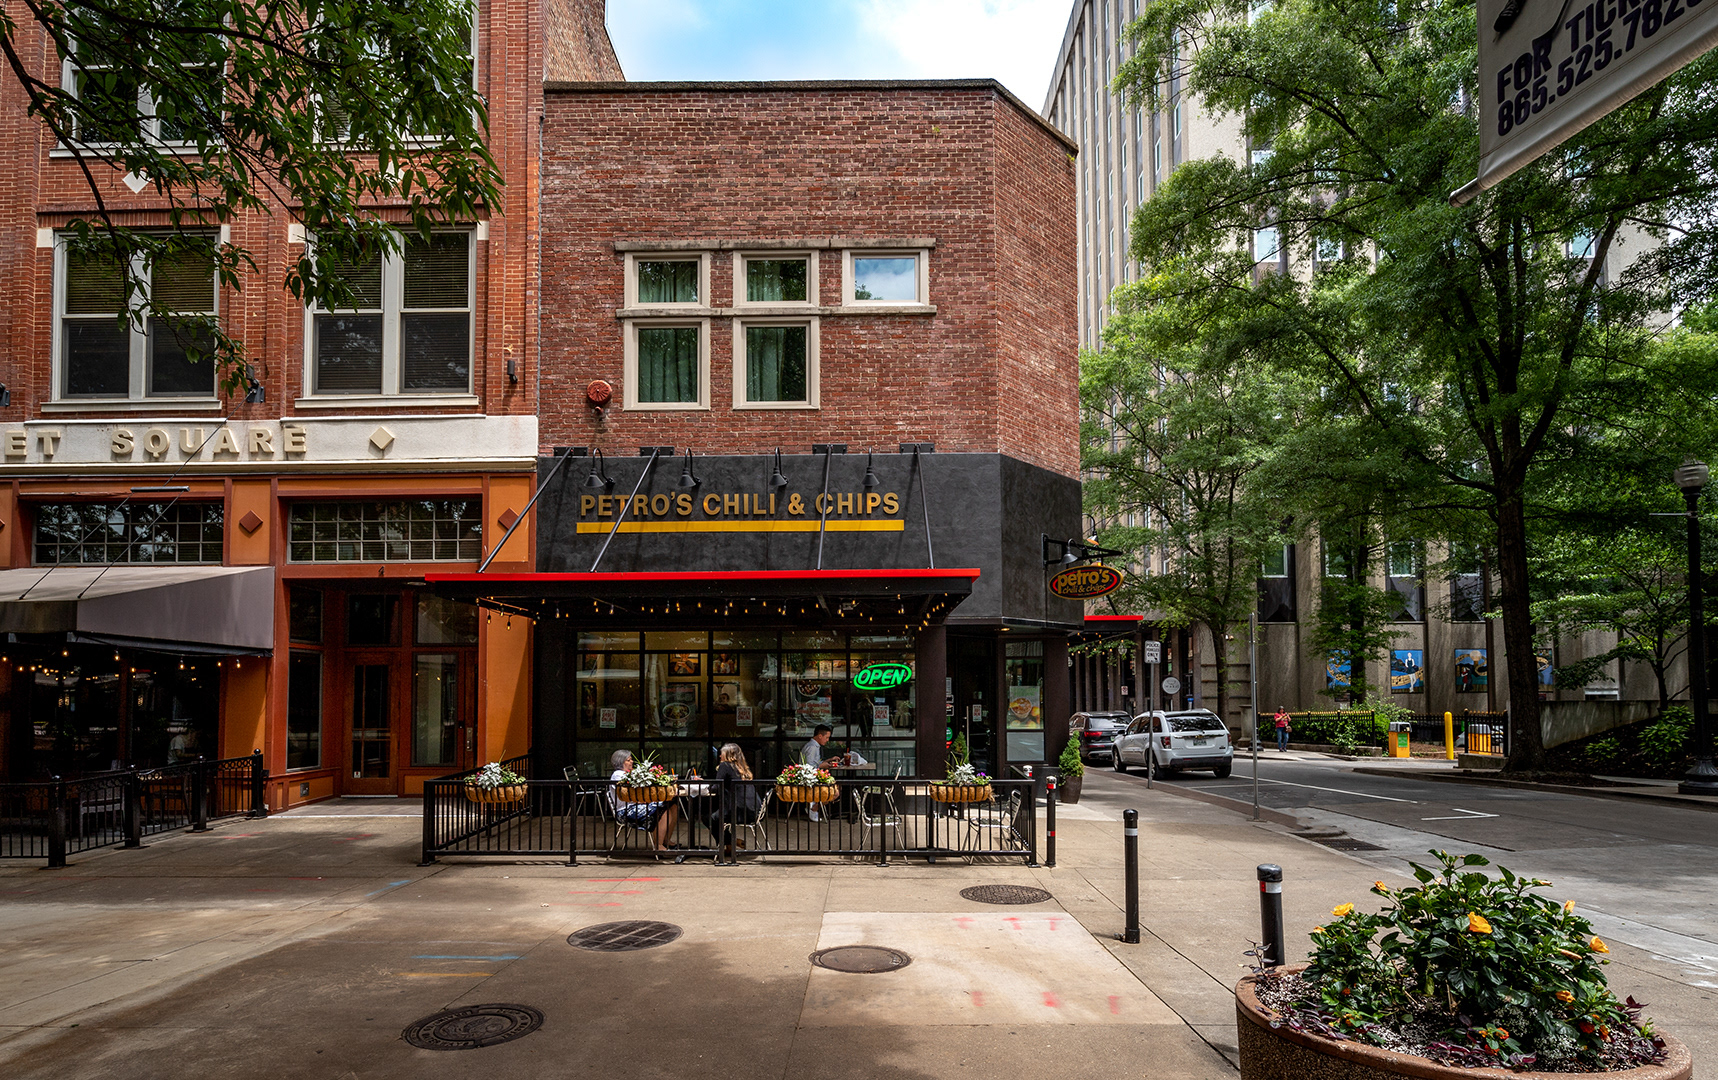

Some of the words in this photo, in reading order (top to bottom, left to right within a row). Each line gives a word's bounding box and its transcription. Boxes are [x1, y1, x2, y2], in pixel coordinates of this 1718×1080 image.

[1497, 0, 1703, 137] 865.525.782
[1497, 38, 1553, 104] FOR
[110, 427, 307, 459] SQUARE
[580, 491, 693, 517] PETRO'S
[703, 493, 775, 515] CHILI
[788, 493, 805, 515] &
[815, 492, 900, 515] CHIPS
[1057, 569, 1110, 594] petro's
[857, 668, 905, 685] OPEN
